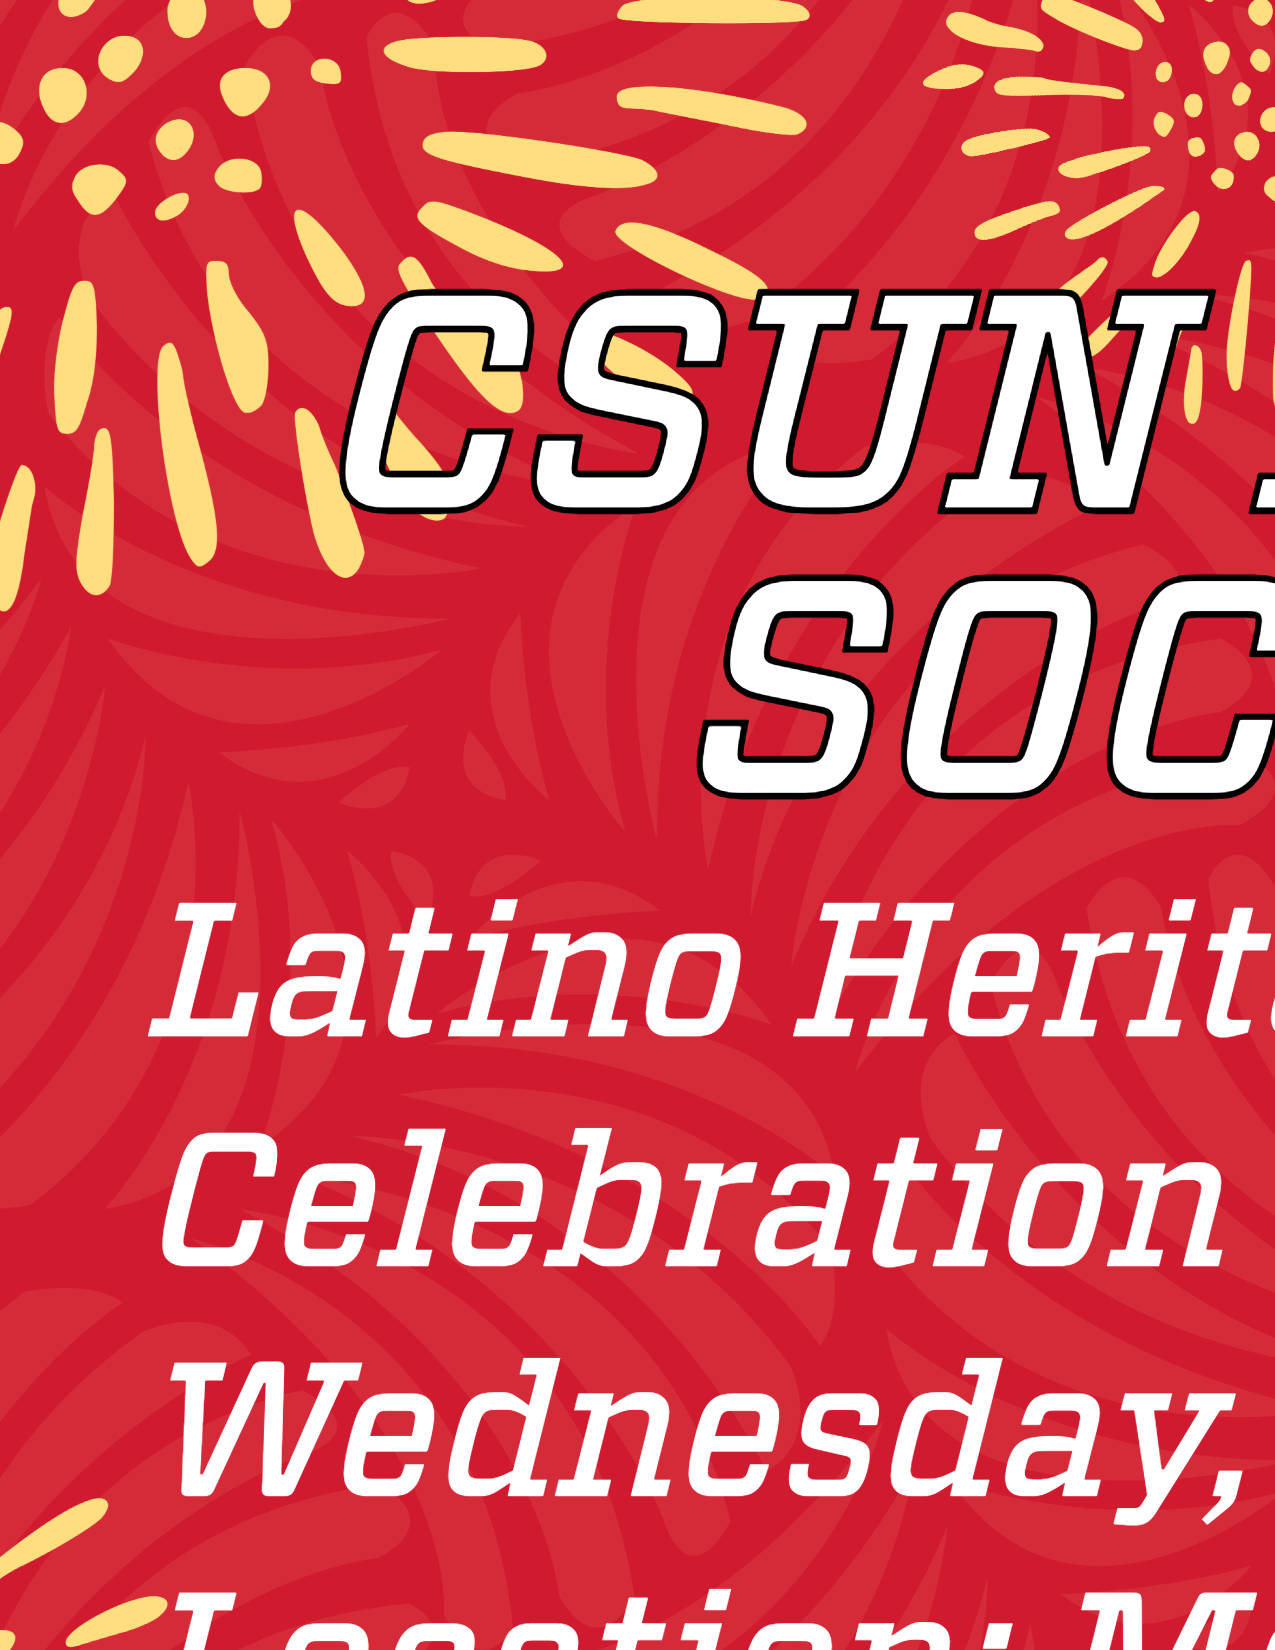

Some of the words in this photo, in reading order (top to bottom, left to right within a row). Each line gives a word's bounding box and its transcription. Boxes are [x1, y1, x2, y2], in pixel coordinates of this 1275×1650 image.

[340, 289, 1214, 513] CSUN
[148, 899, 740, 1037] Latino
[163, 1128, 1222, 1267] Celebration
[171, 1358, 1242, 1525] Wednesday,
